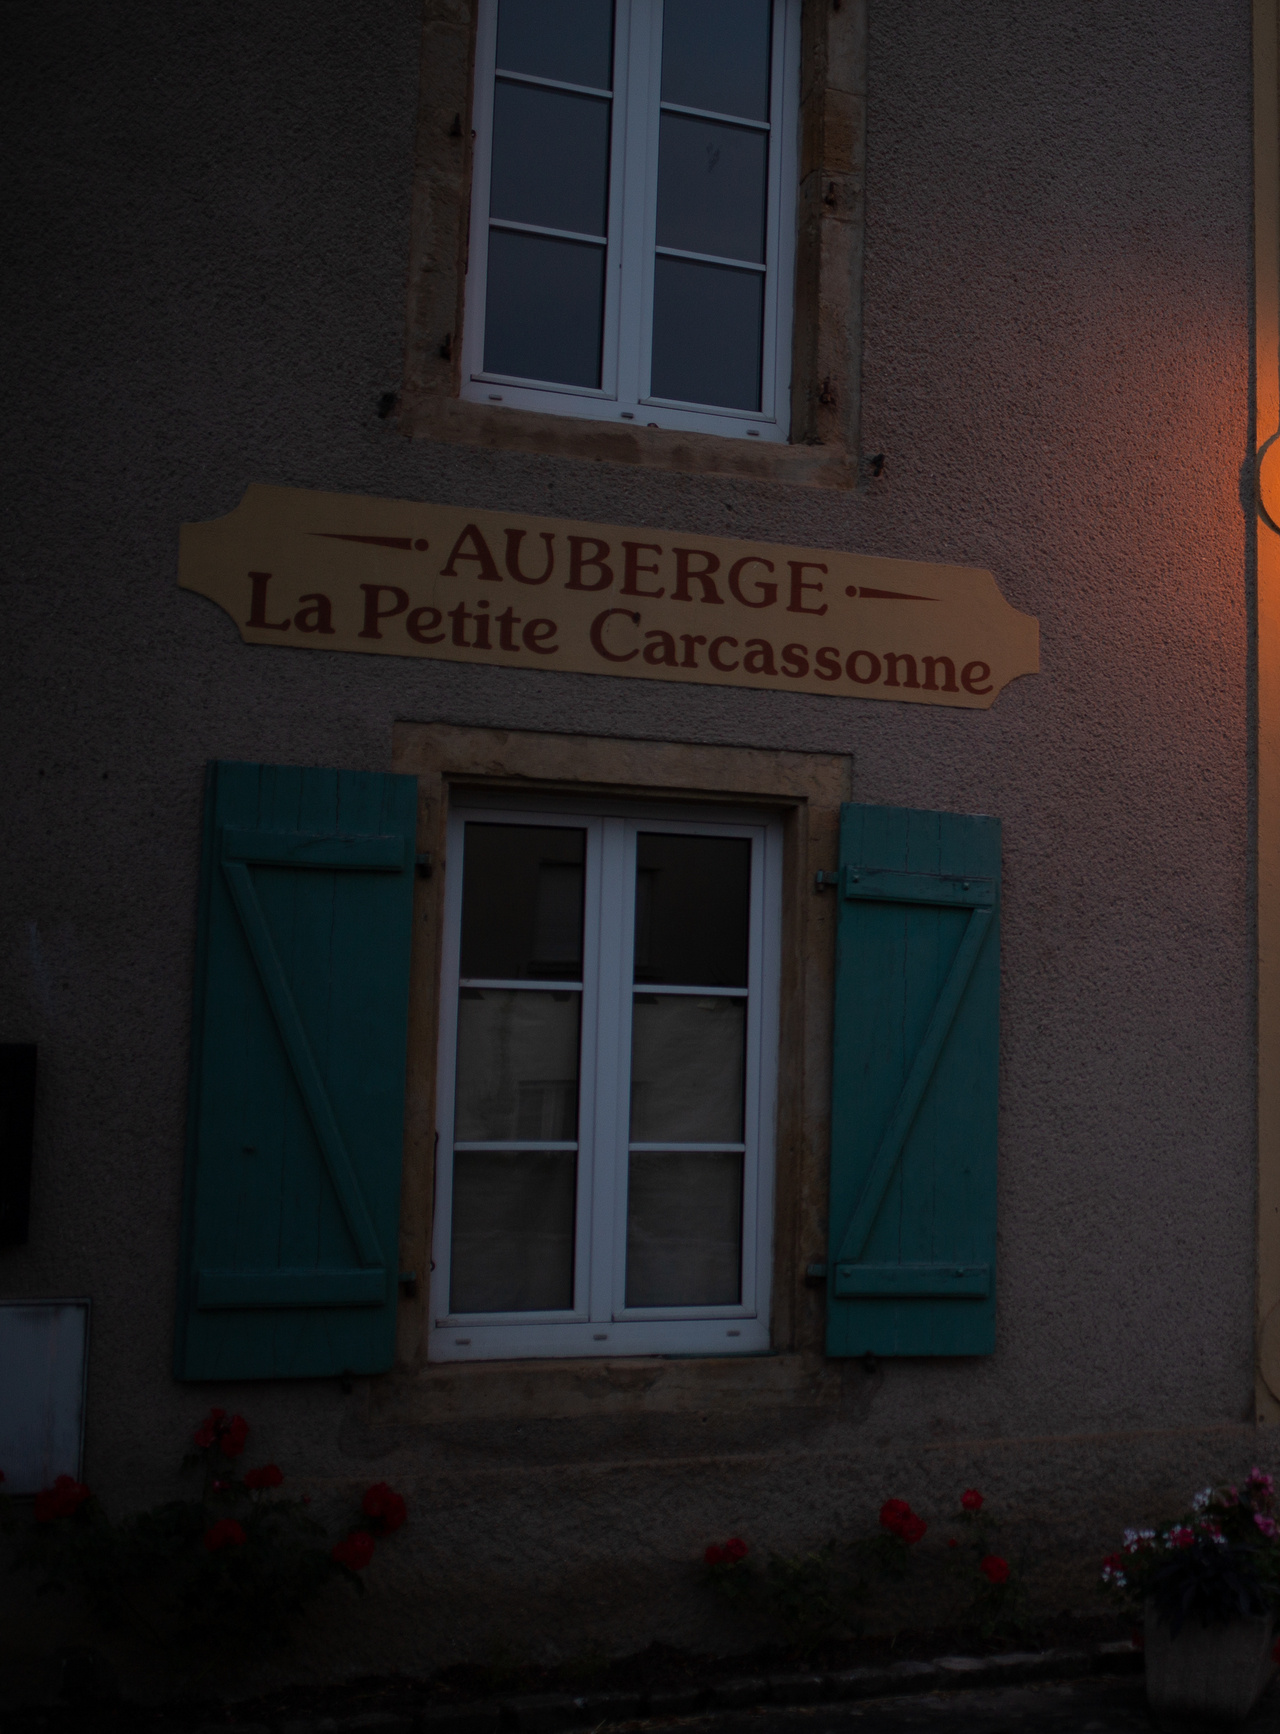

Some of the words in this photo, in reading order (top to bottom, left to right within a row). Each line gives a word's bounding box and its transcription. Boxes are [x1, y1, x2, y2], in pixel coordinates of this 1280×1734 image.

[439, 523, 830, 617] AUBERGE
[246, 571, 337, 635] La
[358, 583, 559, 655] Petite
[590, 607, 995, 697] Carcassonne
